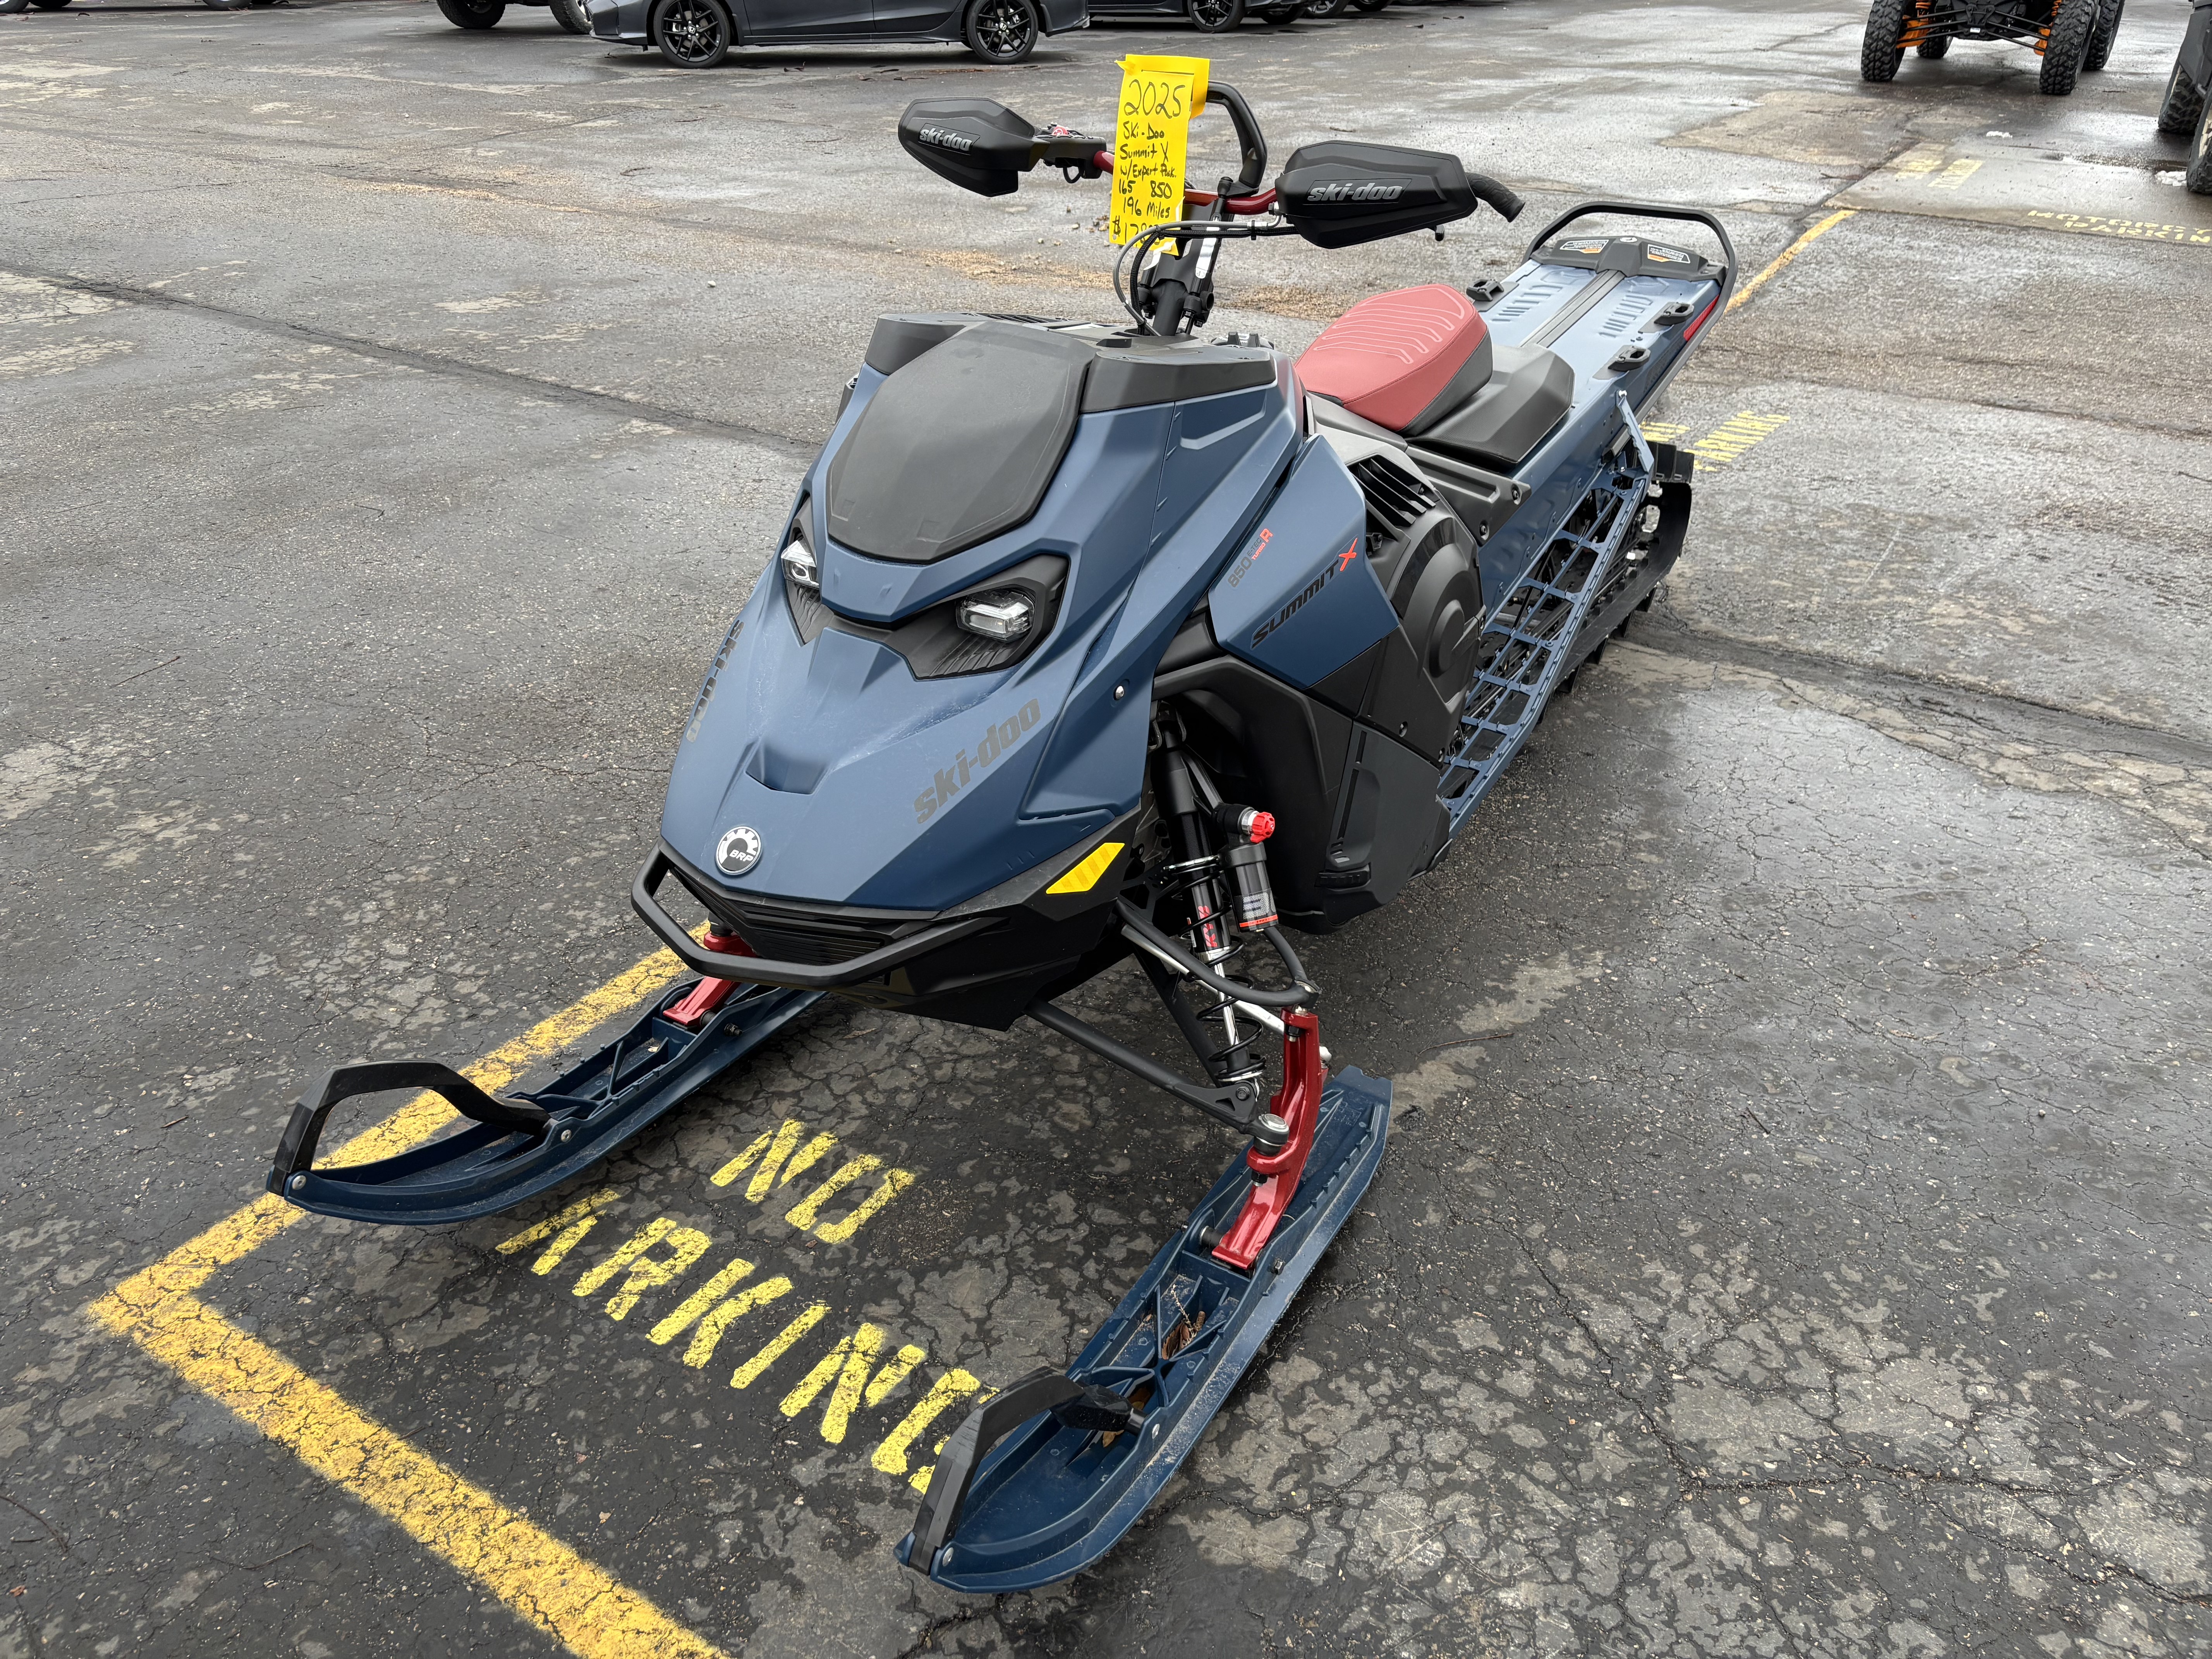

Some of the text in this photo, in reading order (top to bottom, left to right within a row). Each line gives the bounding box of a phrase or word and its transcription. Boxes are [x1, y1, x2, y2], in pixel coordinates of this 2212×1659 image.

[1124, 79, 1185, 119] 2025
[920, 128, 973, 151] ski-doo
[1120, 141, 1168, 163] Summit X
[1119, 179, 1172, 199] 165 850
[1307, 182, 1403, 201] ski-doo
[1123, 196, 1170, 220] 196 Miles
[1228, 528, 1273, 587] 850 E-TEC TURBO R
[1252, 538, 1358, 649] SUMMIT X
[914, 698, 1041, 824] ski-doo
[729, 849, 754, 862] BRP
[710, 1118, 917, 1243] NO
